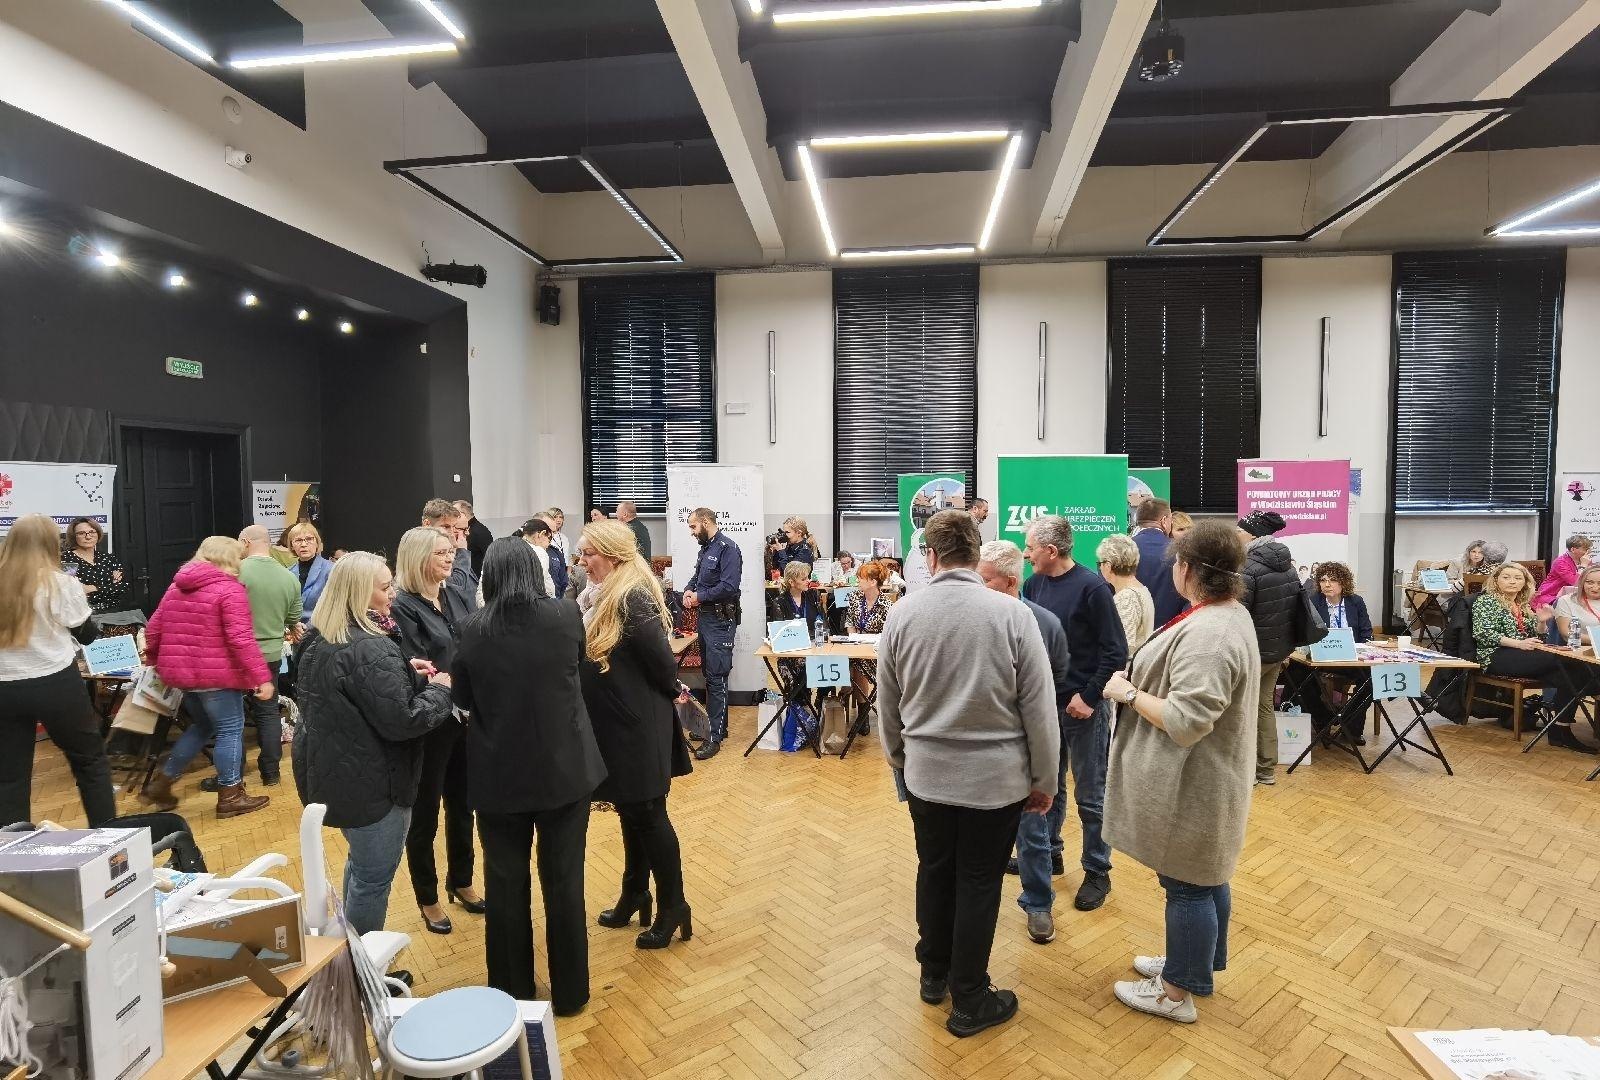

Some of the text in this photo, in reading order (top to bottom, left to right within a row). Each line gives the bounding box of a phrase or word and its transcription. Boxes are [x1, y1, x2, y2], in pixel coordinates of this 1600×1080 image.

[1246, 490, 1291, 498] POWIATOWY
[1317, 489, 1342, 498] PRACY
[1064, 506, 1096, 514] ZAKŁAD
[1070, 524, 1120, 532] POŁECZNYCH
[816, 663, 841, 682] 15
[1380, 672, 1407, 693] 13
